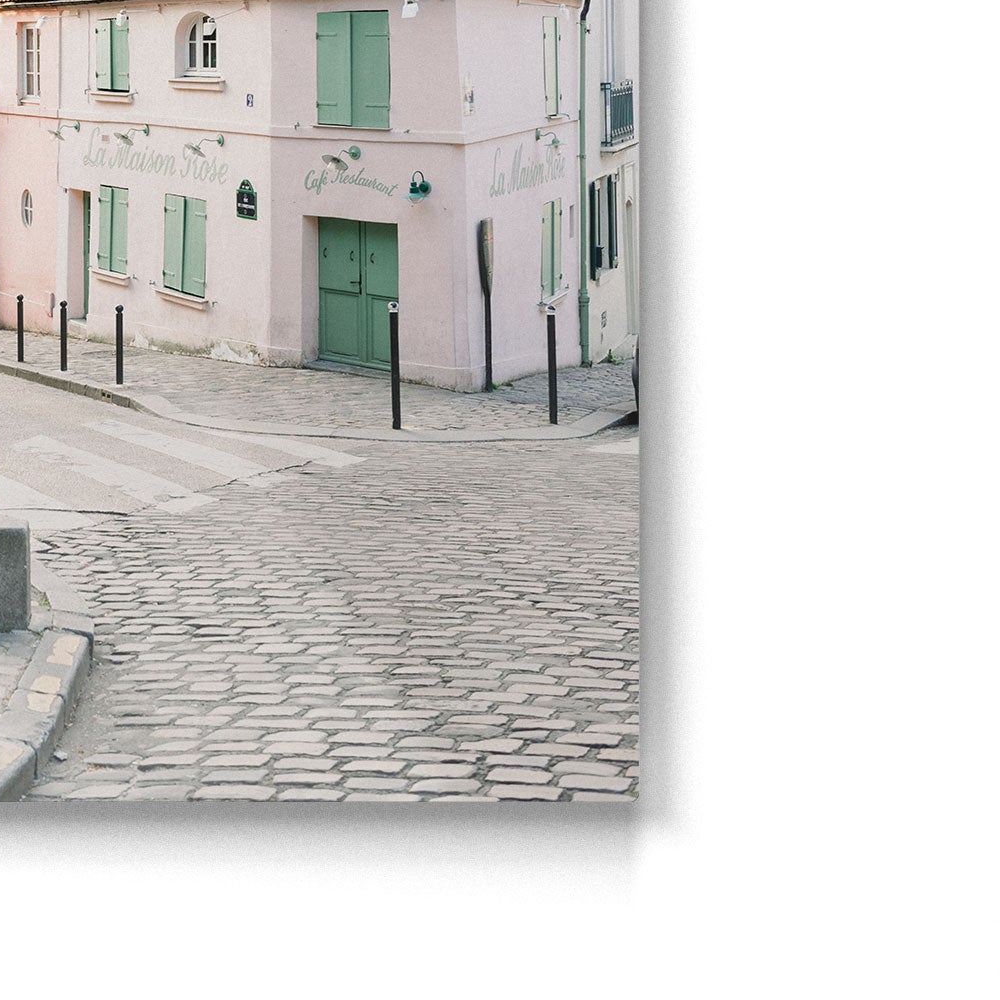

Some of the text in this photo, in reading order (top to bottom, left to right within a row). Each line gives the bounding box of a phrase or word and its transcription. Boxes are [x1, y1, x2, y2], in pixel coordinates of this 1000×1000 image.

[84, 126, 230, 185] La Maison Rose
[489, 147, 506, 197] La
[331, 167, 399, 197] Restaurant
